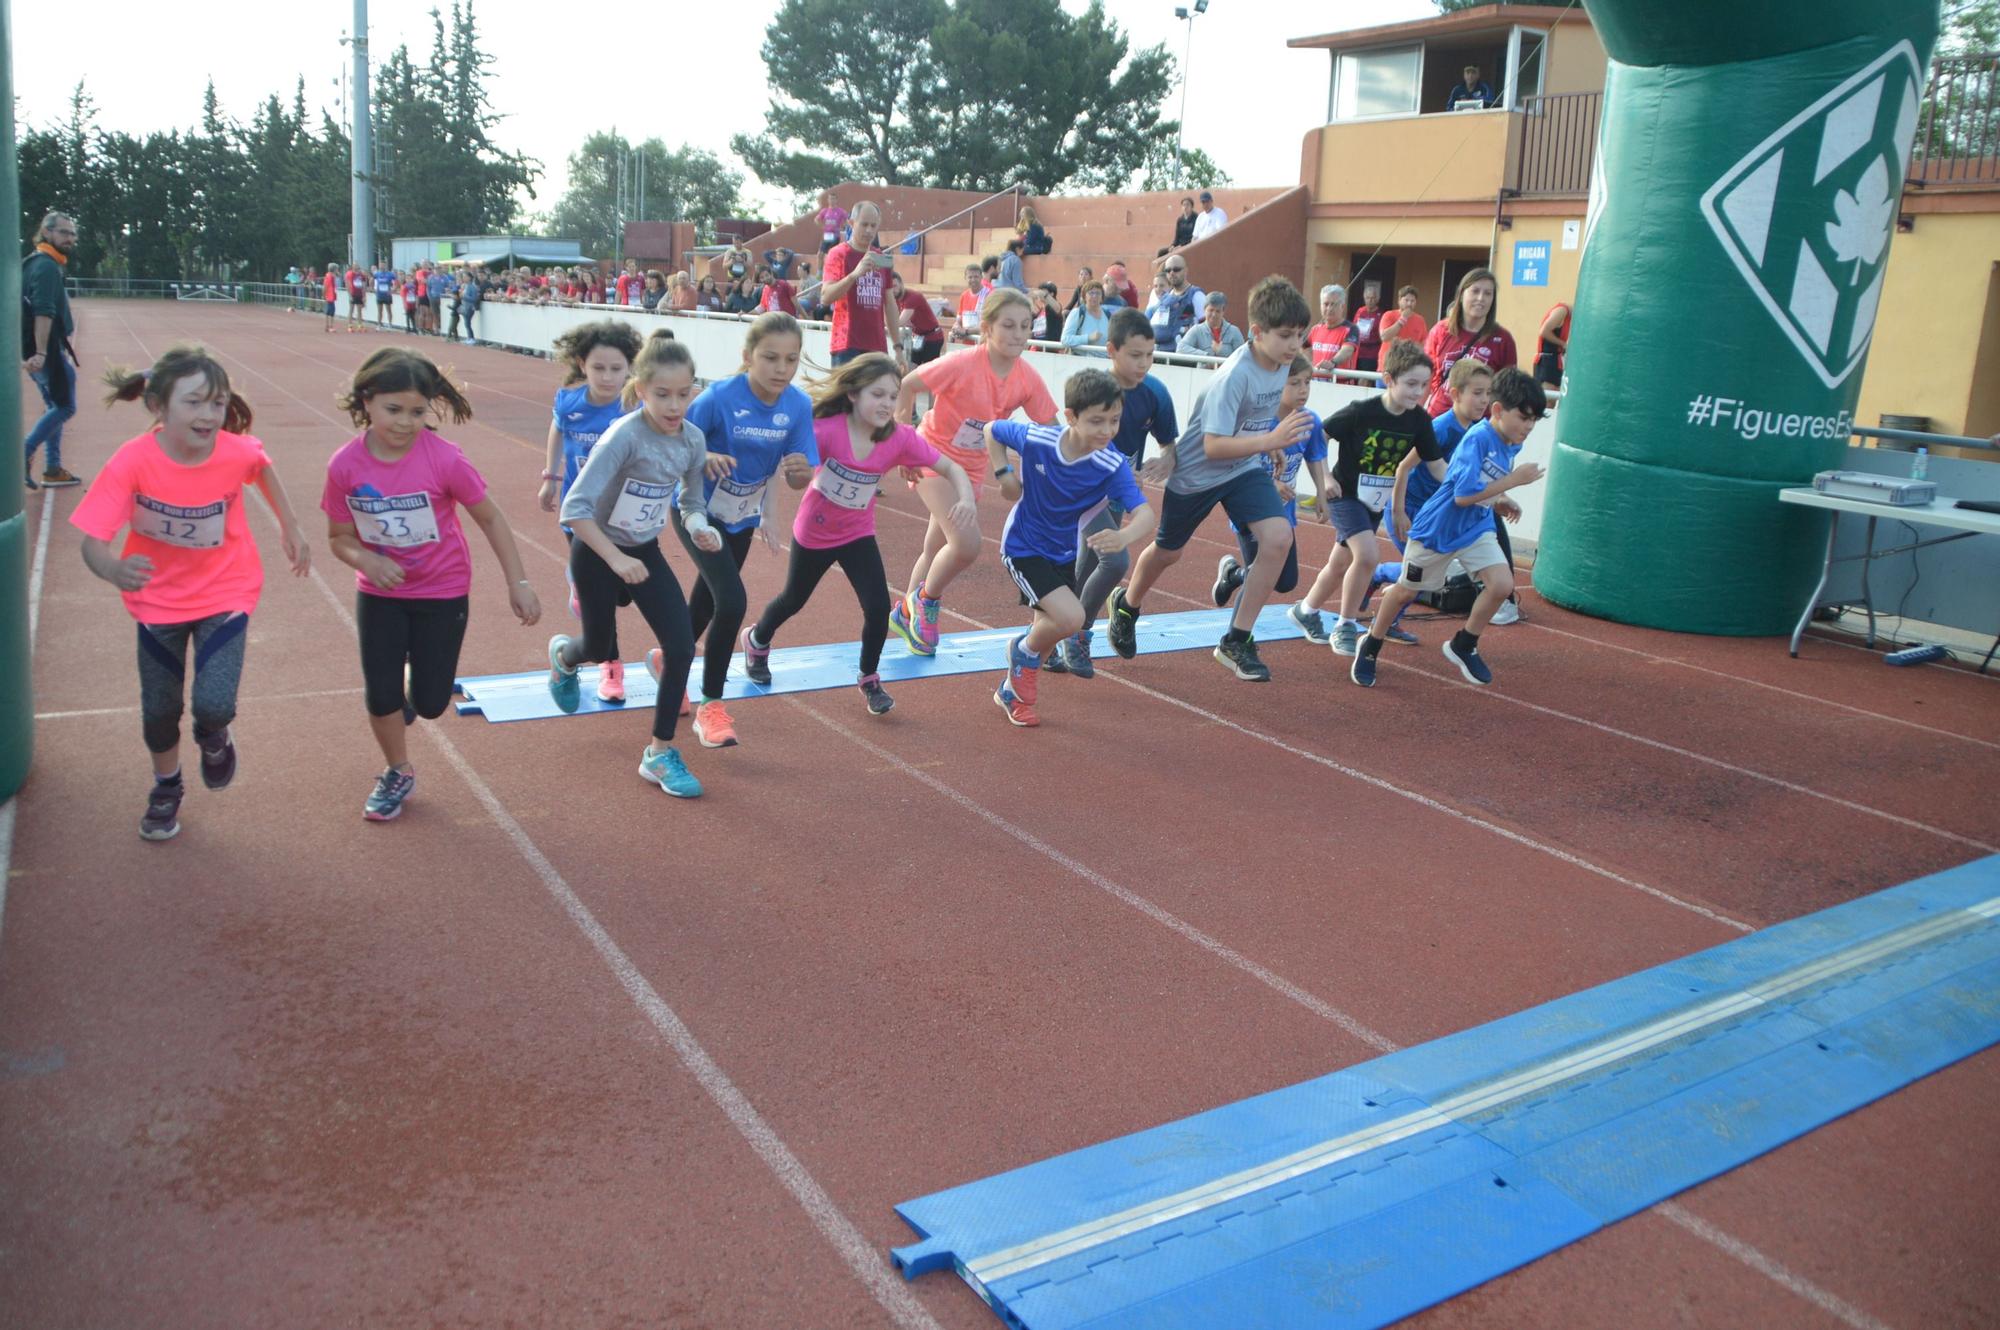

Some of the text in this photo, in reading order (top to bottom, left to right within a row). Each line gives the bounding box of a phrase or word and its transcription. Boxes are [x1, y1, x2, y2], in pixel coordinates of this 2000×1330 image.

[1518, 247, 1546, 260] BRIGADA
[1522, 268, 1538, 281] JOVE
[856, 286, 881, 297] CASTELL
[639, 487, 649, 495] XV
[831, 482, 859, 500] 13
[1372, 491, 1382, 505] 2
[184, 502, 220, 517] CASTELL
[635, 503, 662, 522] 50
[160, 520, 196, 540] 12
[375, 517, 410, 537] 23
